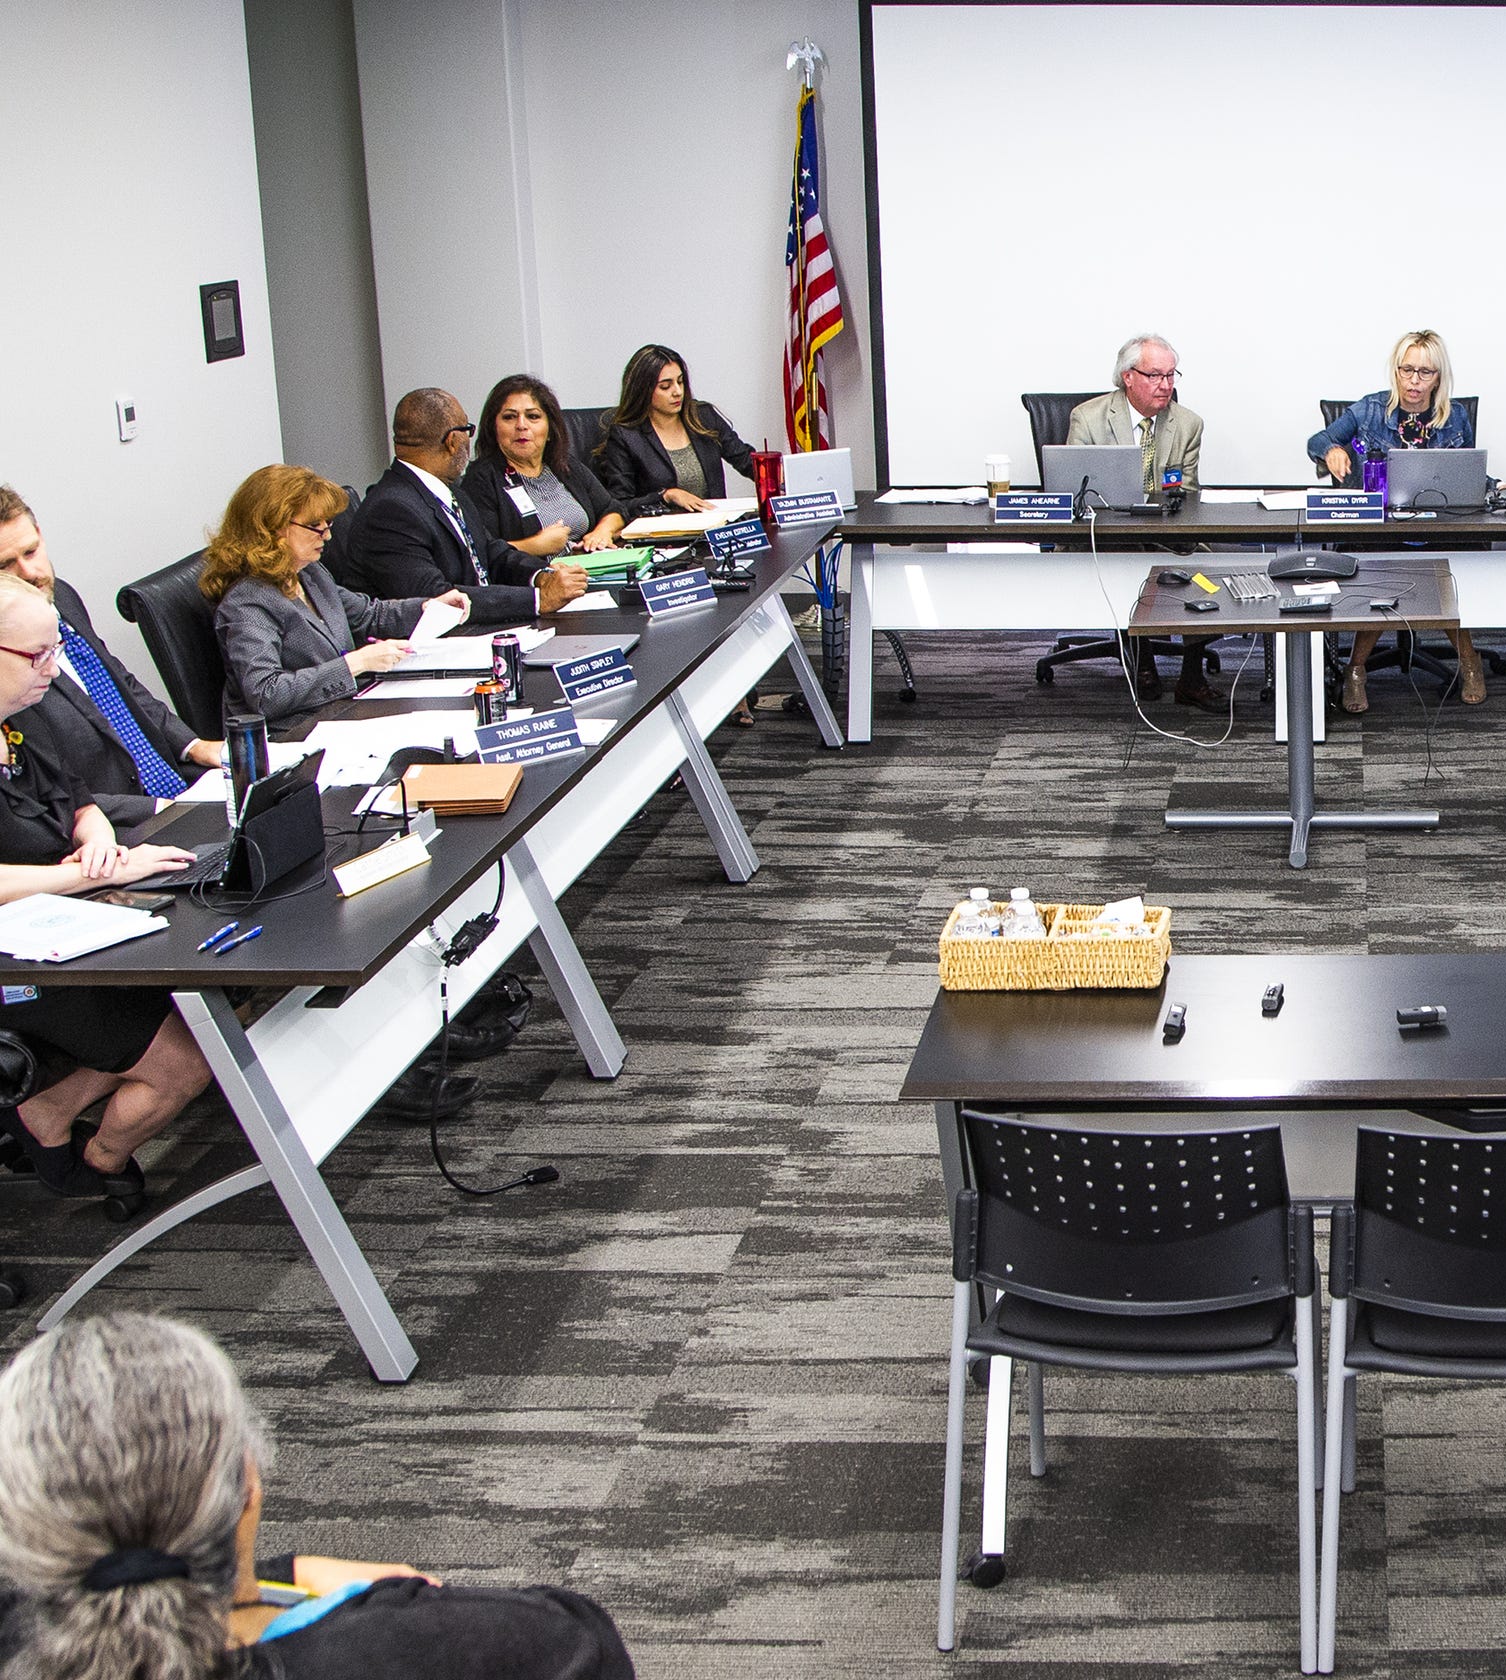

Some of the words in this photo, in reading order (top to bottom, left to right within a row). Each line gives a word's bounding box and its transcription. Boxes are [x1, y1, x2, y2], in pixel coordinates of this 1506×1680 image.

[1019, 510, 1048, 519] Secretary
[655, 582, 671, 592] GARY
[666, 594, 698, 606] Investigator
[570, 663, 591, 677] JUDITH
[590, 655, 614, 670] STAPLEY
[575, 683, 603, 696] Executive
[602, 675, 624, 688] Director
[495, 724, 531, 740] THOMAS
[532, 718, 558, 732] RAINE
[495, 752, 514, 763] Asst.
[516, 745, 544, 758] Attorney
[546, 737, 572, 751] General
